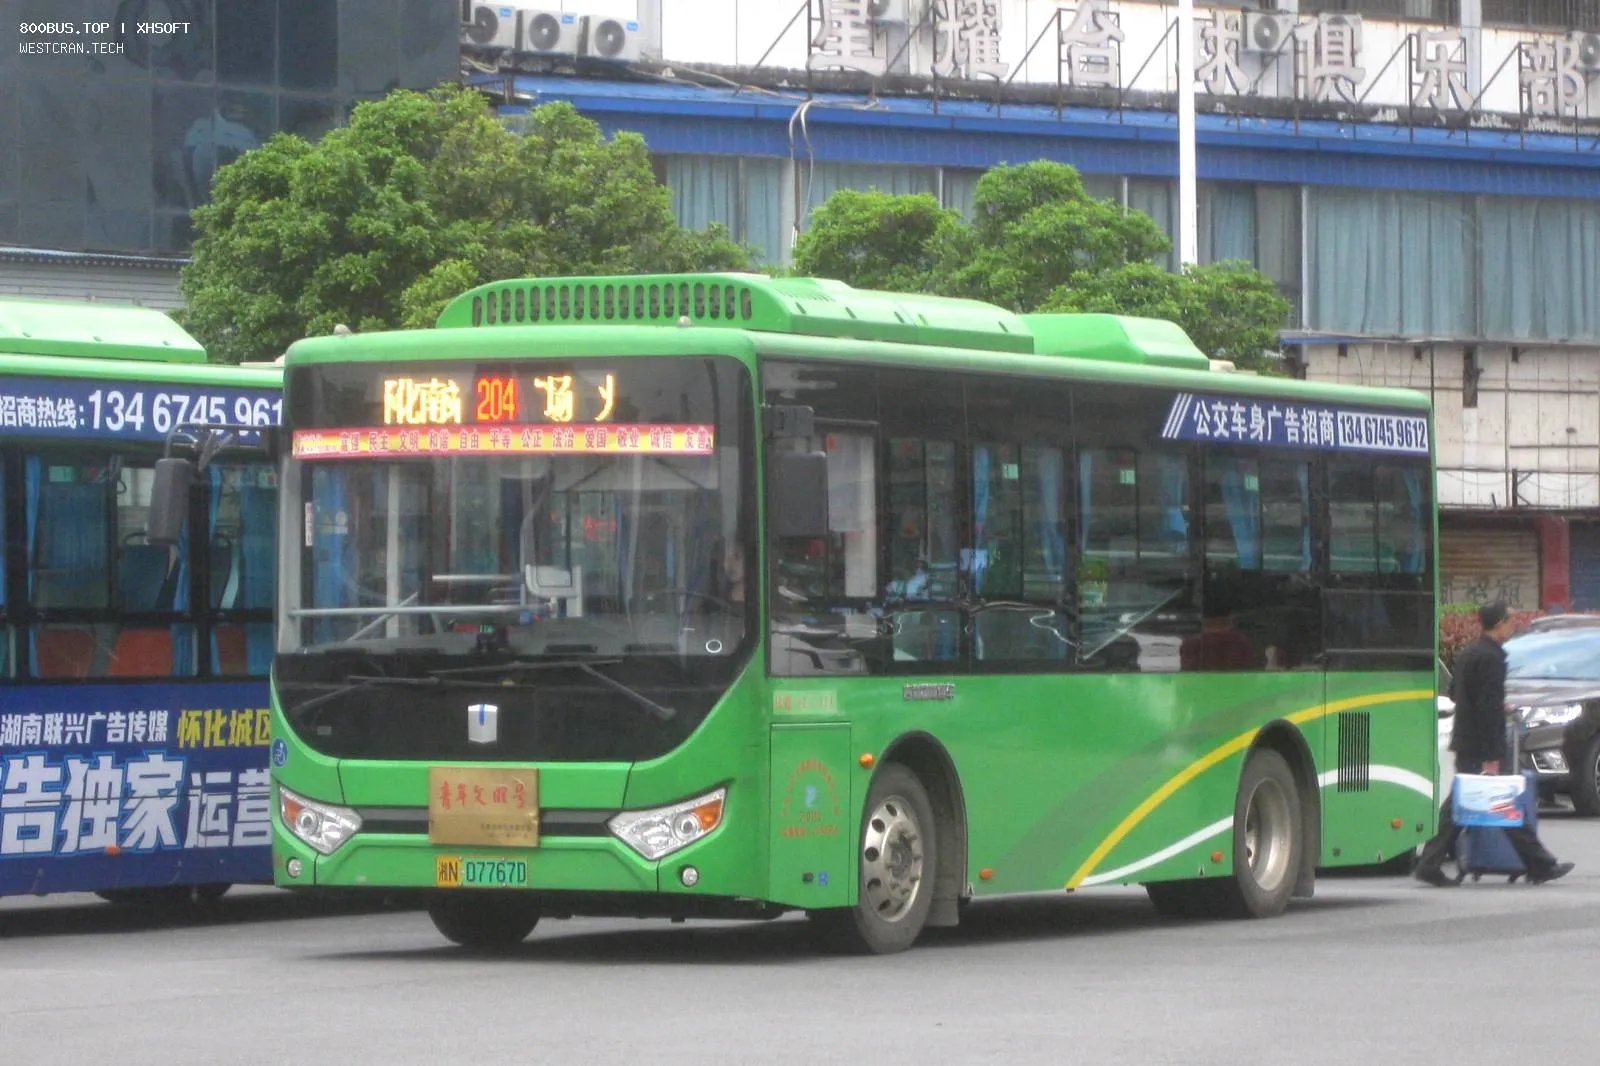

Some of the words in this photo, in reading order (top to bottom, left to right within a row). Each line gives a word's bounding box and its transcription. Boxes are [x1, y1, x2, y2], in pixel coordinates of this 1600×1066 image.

[88, 389, 144, 432] 134
[152, 393, 226, 435] 6745
[476, 378, 517, 421] 204
[368, 431, 390, 451] 民主
[399, 430, 419, 450] 文明
[459, 430, 480, 449] 自由
[489, 428, 512, 449] 平等
[521, 429, 543, 448] 公正
[552, 428, 575, 449] 法治
[584, 428, 609, 449] 爱国
[1193, 400, 1335, 446] 公交车身广告招商
[1340, 411, 1362, 444] 134
[1364, 414, 1395, 447] 6745
[1396, 417, 1427, 449] 9612
[1, 710, 169, 746] 湖南联兴广告传媒
[177, 709, 270, 748] 怀化城区
